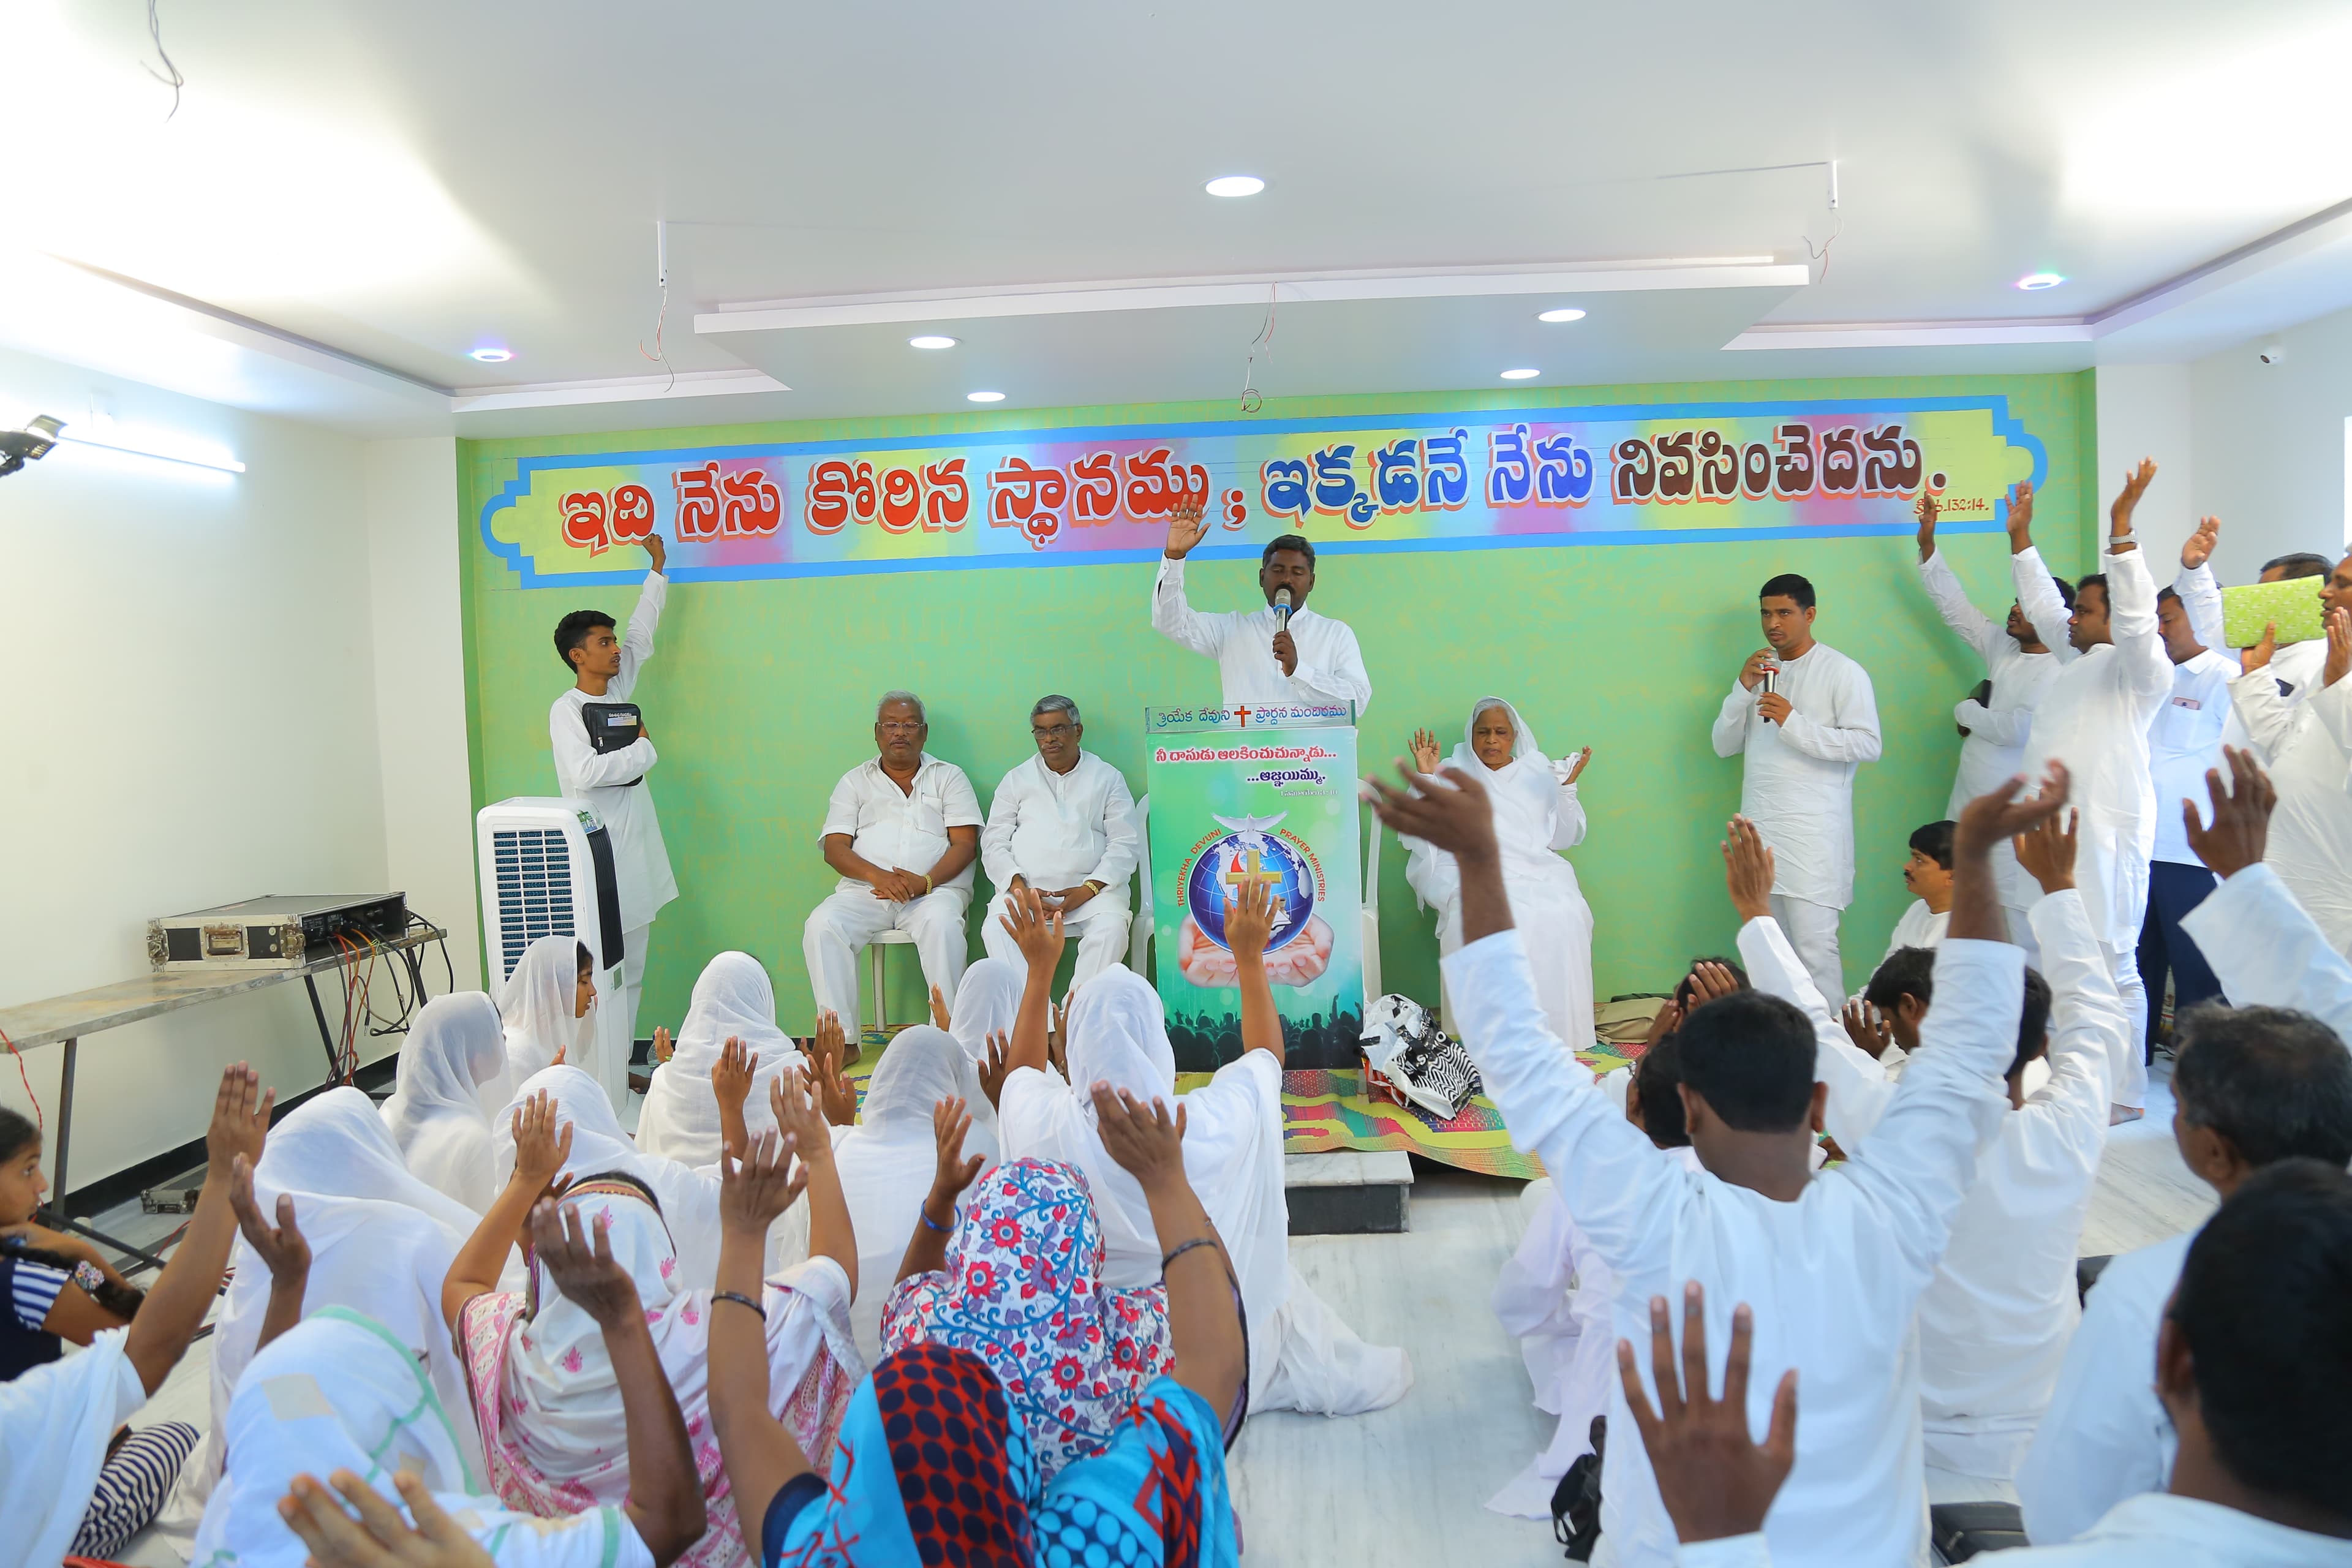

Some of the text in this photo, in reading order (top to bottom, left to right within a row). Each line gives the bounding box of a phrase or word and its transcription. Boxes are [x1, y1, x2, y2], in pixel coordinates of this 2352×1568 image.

[559, 481, 657, 559] ఇది
[672, 459, 785, 543] నేను
[804, 456, 970, 535] కోరిన
[1259, 426, 1471, 530] ఇక్కడనే
[1487, 422, 1595, 510] నేను
[1199, 707, 1231, 723] దేవుని
[1291, 705, 1347, 718] మందిరము
[1156, 748, 1167, 761] నీ
[1169, 748, 1215, 761] దాసుడు
[1177, 828, 1221, 907] THRIYEKHA DEVUNI
[1280, 828, 1325, 902] PRAYER MINISTRIES
